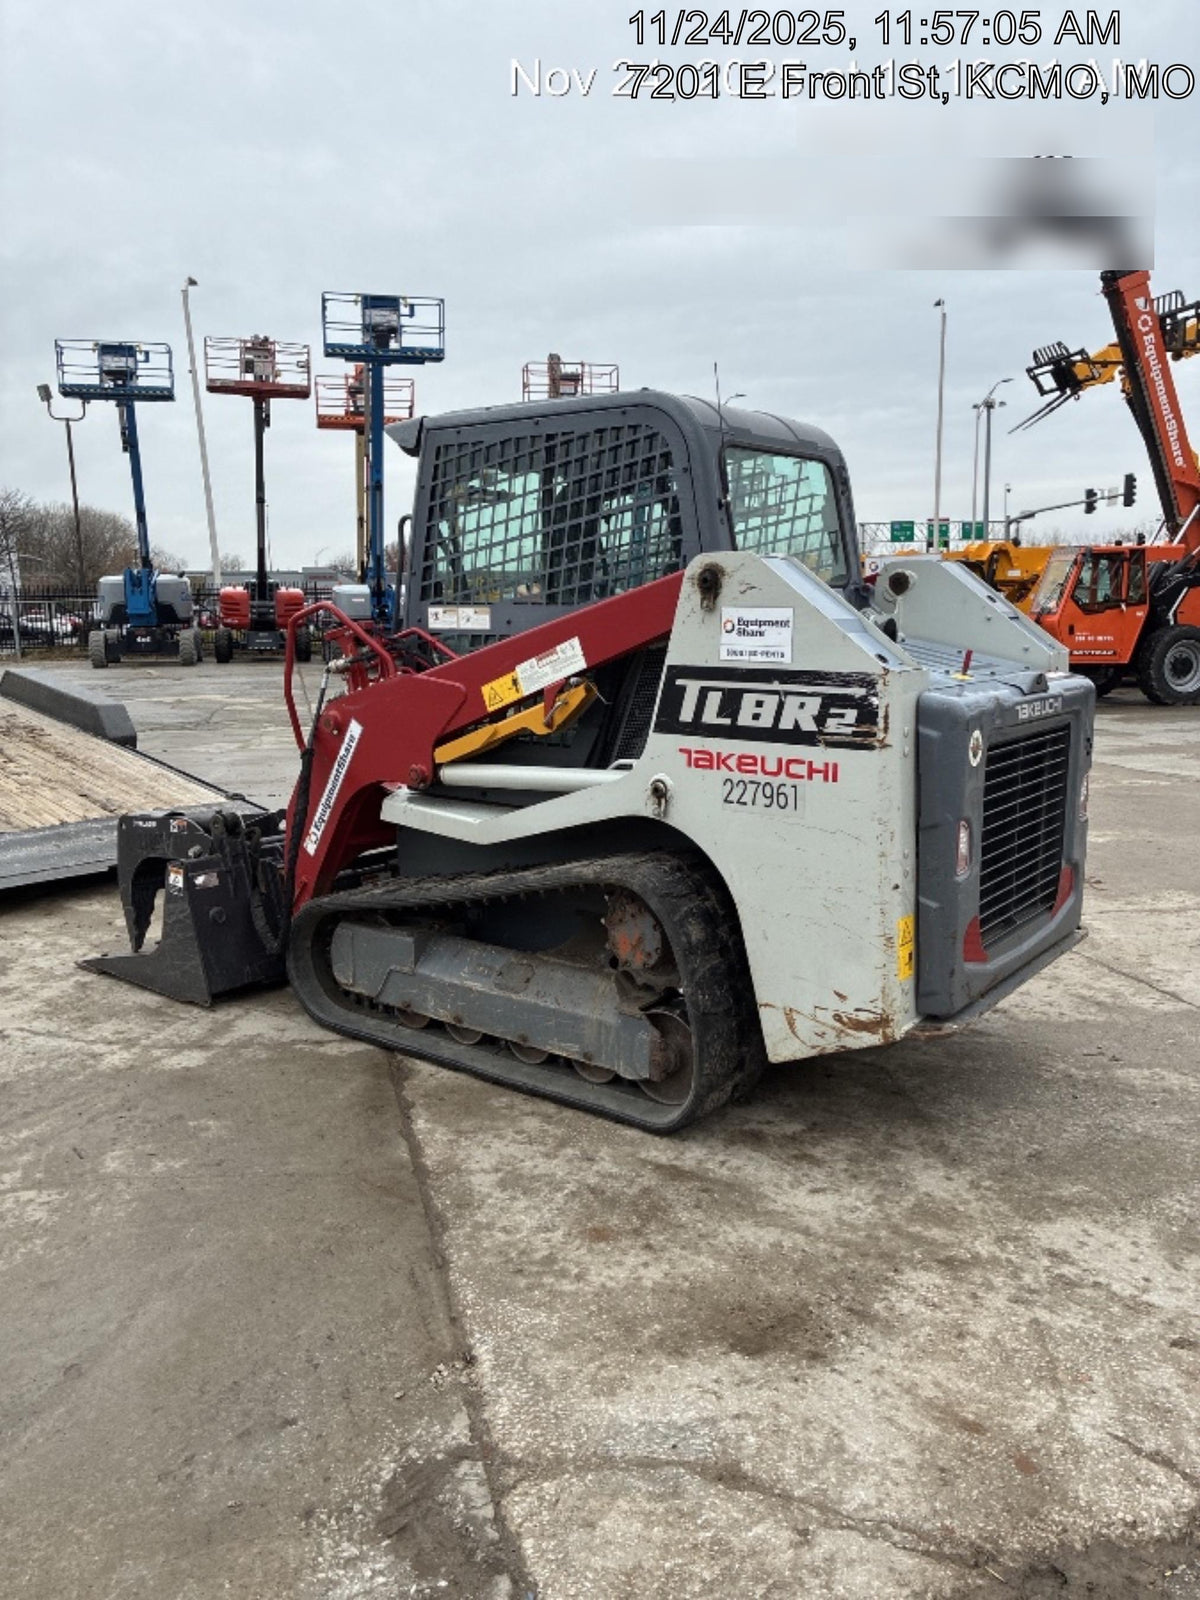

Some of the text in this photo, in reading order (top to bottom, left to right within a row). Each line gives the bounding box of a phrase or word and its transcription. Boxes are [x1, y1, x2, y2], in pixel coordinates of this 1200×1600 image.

[736, 616, 791, 628] Equipment
[675, 679, 864, 734] TL8R2
[722, 778, 799, 812] 227961
